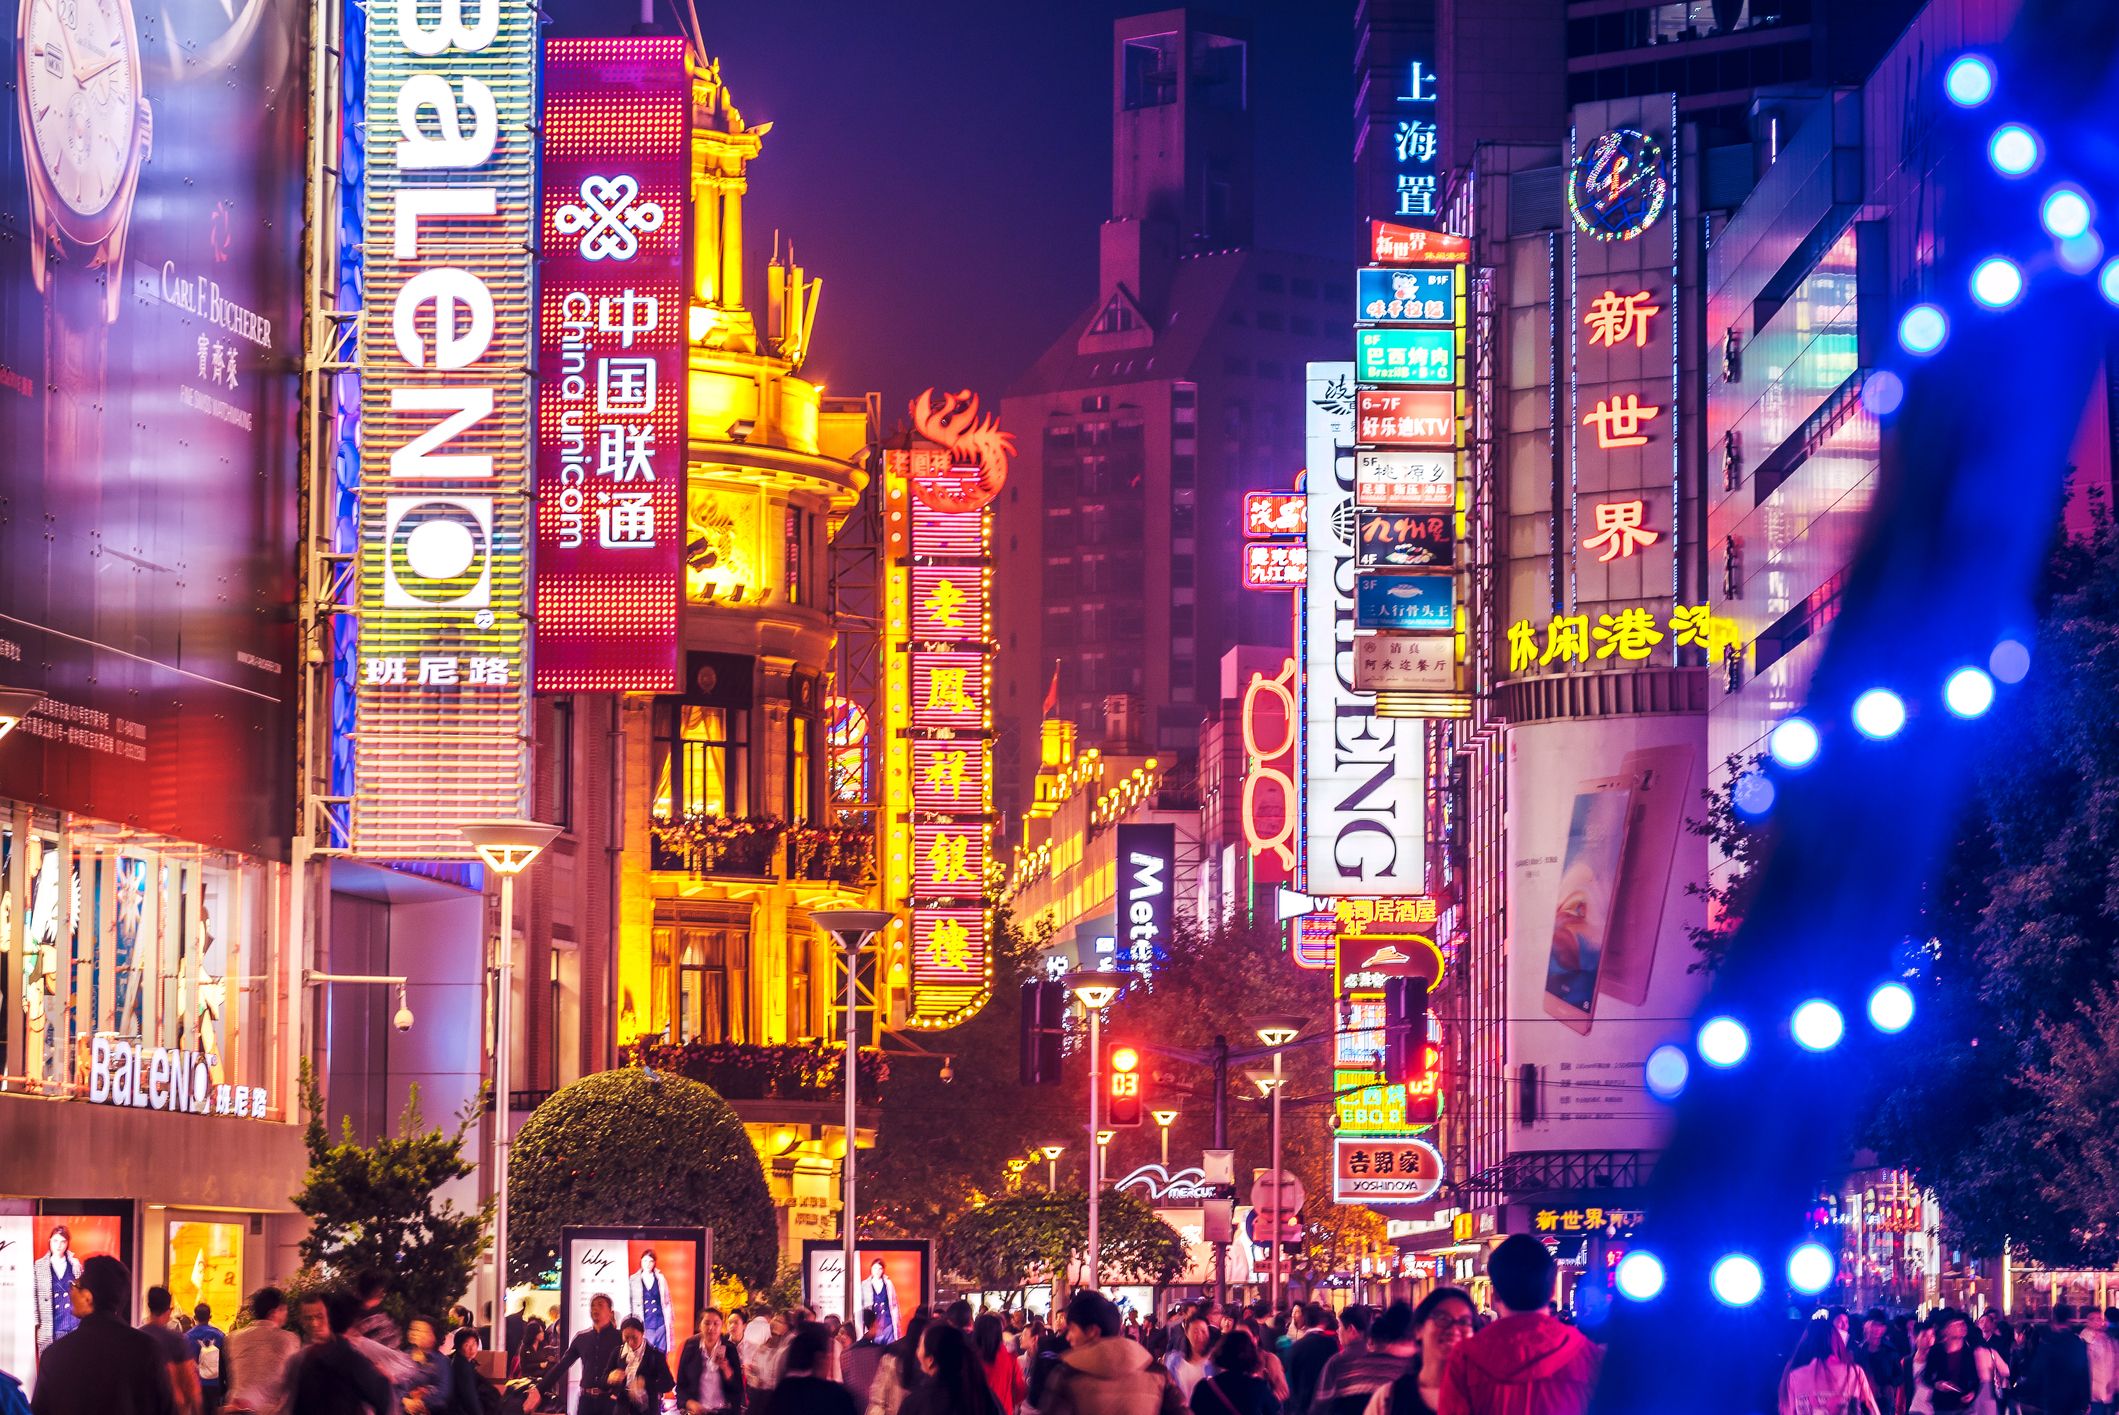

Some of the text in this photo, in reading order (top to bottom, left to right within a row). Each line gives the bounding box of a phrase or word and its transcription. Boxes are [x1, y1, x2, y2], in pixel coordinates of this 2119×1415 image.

[1394, 61, 1437, 216] 上海置
[209, 281, 272, 349] BUCHERER
[596, 288, 657, 550] 中国联通
[1583, 289, 1660, 564] 新世界
[1363, 456, 1378, 467] 5F
[559, 410, 591, 550] unicom
[1360, 553, 1378, 565] 4F
[1362, 579, 1378, 590] 3F
[364, 656, 511, 687] 班尼路
[1344, 922, 1367, 936] 4F
[1111, 1073, 1139, 1096] 03
[1349, 1150, 1420, 1175] 吉野家
[1353, 1180, 1419, 1192] YOSHINOYA
